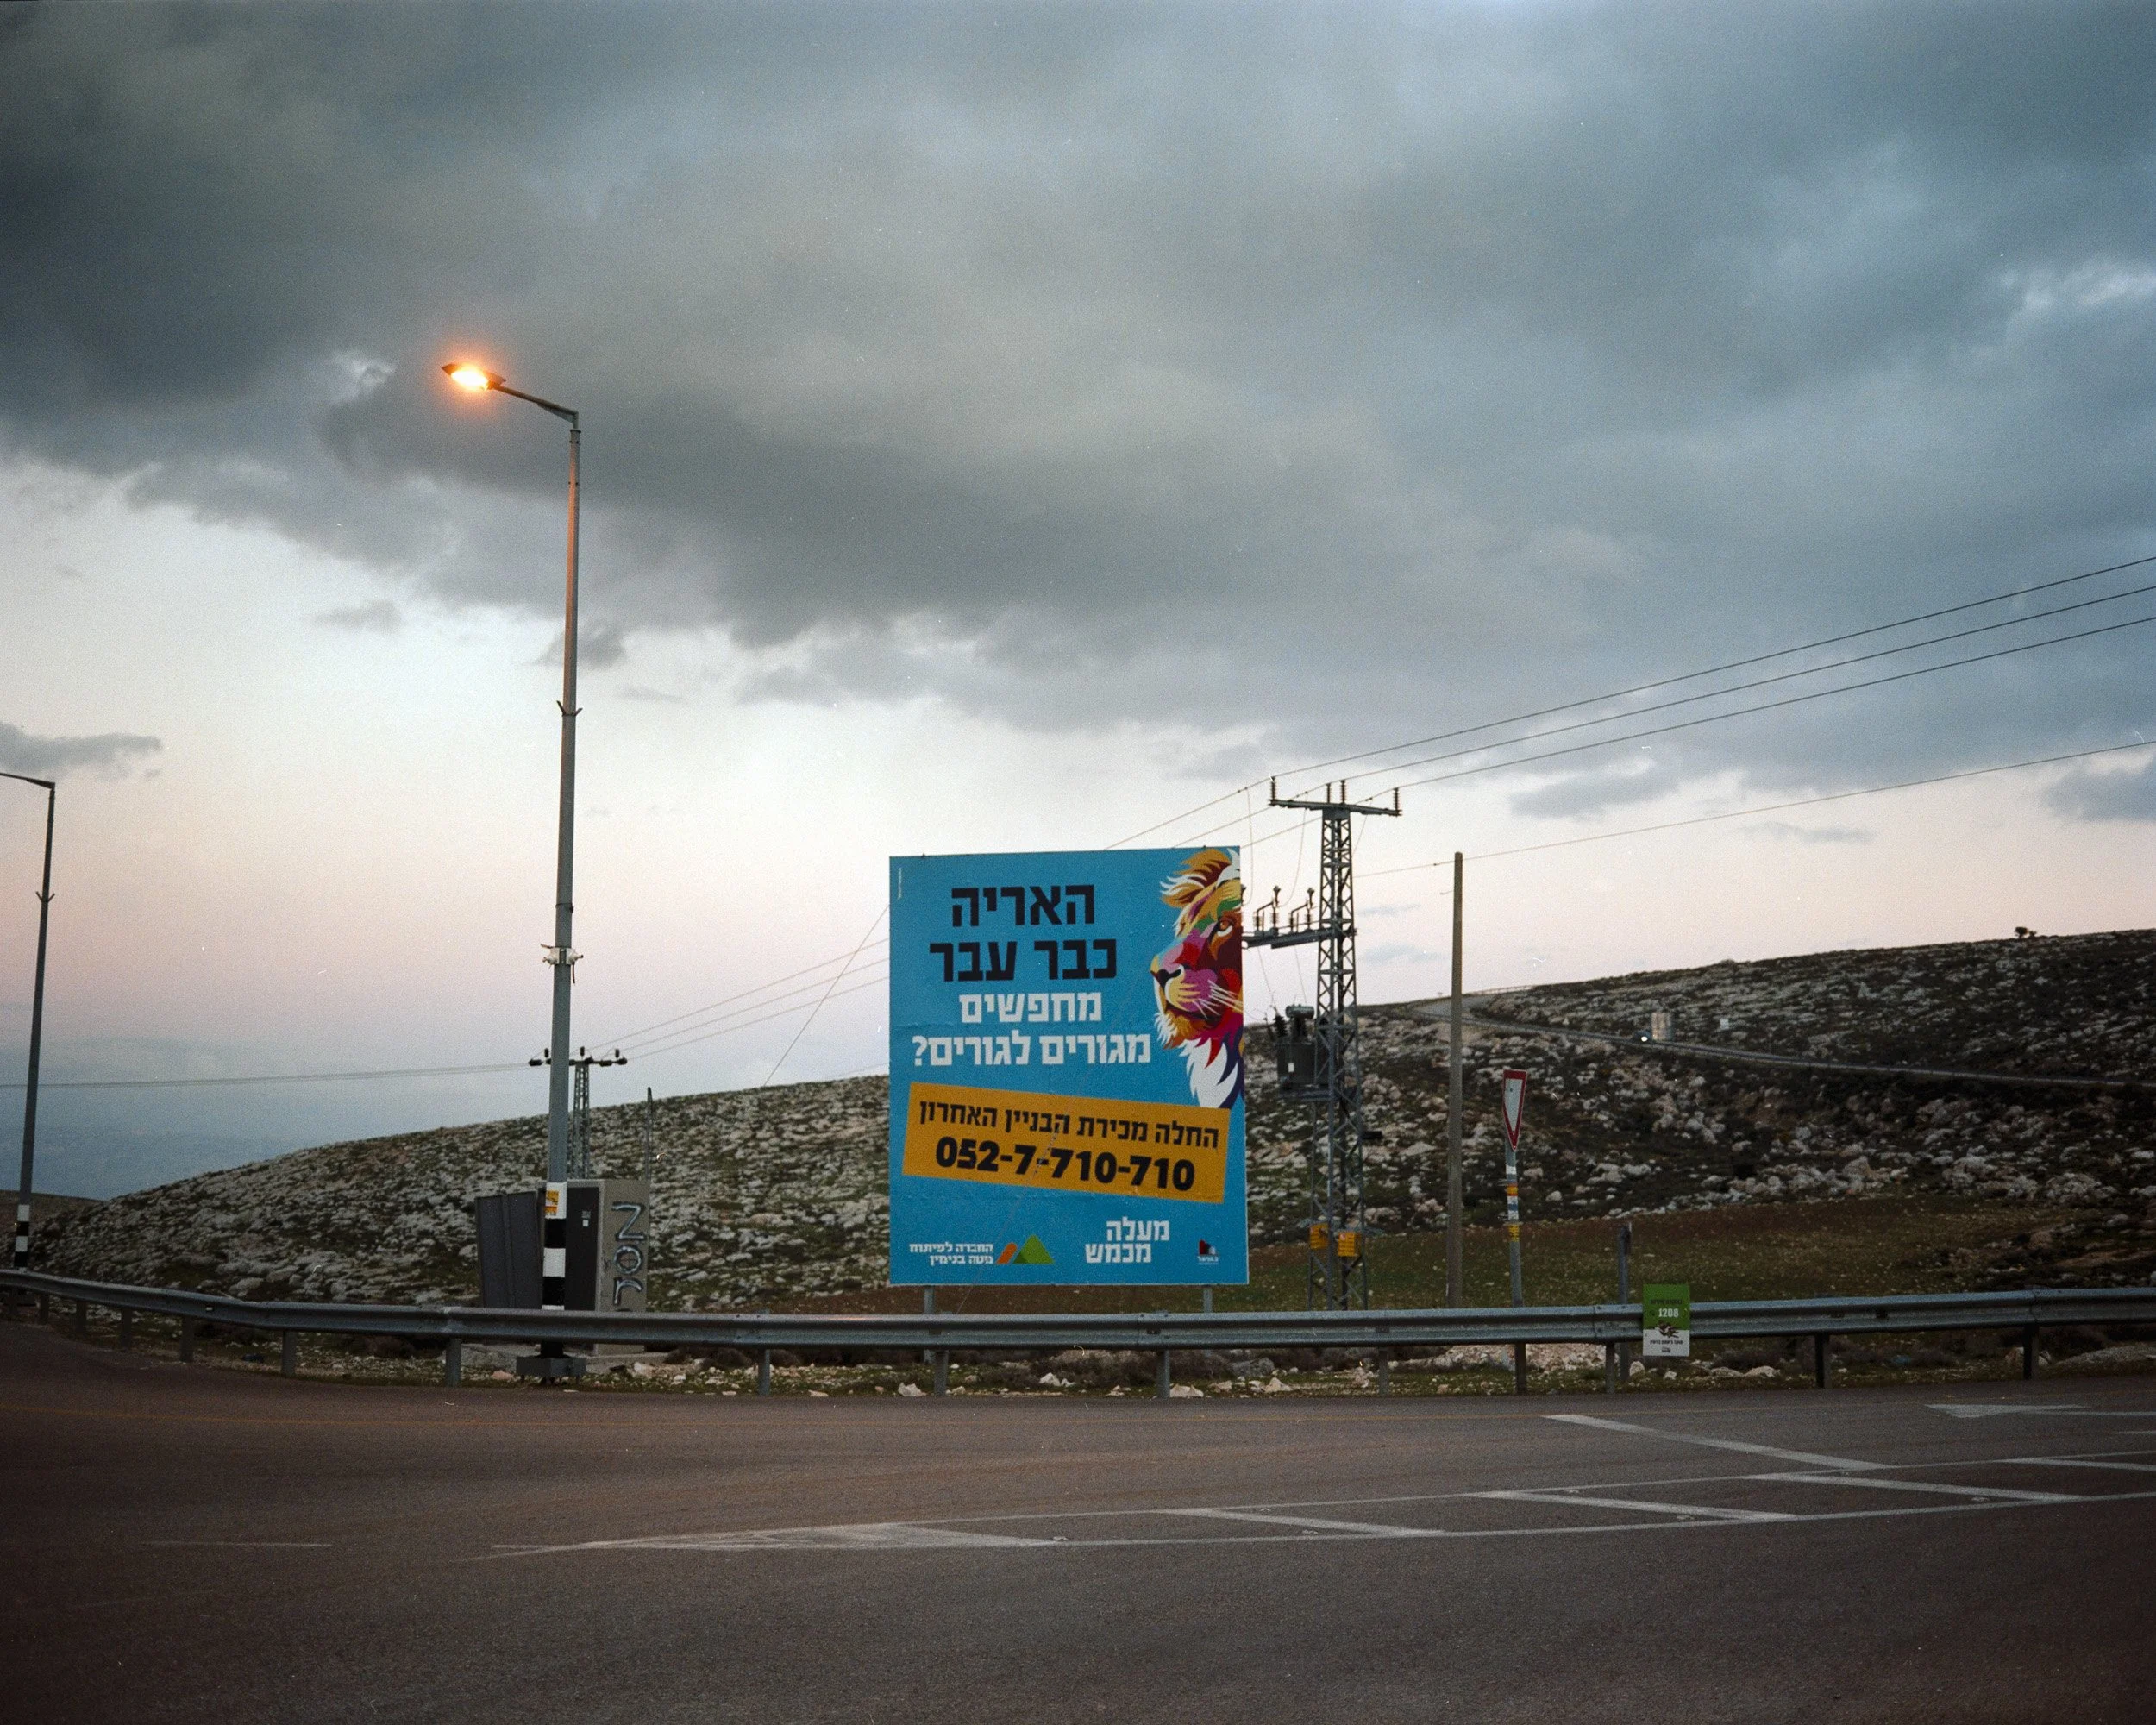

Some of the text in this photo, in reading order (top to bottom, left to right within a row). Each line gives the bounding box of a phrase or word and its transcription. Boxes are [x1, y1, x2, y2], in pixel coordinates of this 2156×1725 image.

[952, 885, 1094, 926] האריה
[930, 939, 1116, 982] כבר עבר
[960, 993, 1101, 1023] מחפשים
[912, 1030, 1150, 1065] מגורים לגורים?
[920, 1101, 1219, 1148] החלה מכירת הבניין האחרון
[936, 1136, 1195, 1191] 052-7-710-710
[1107, 1217, 1169, 1240] מעלה
[909, 1239, 993, 1253] החברה לפיתוח
[930, 1255, 993, 1267] מטה בנימין
[1086, 1239, 1150, 1263] מכמש
[1658, 1308, 1679, 1318] 1208
